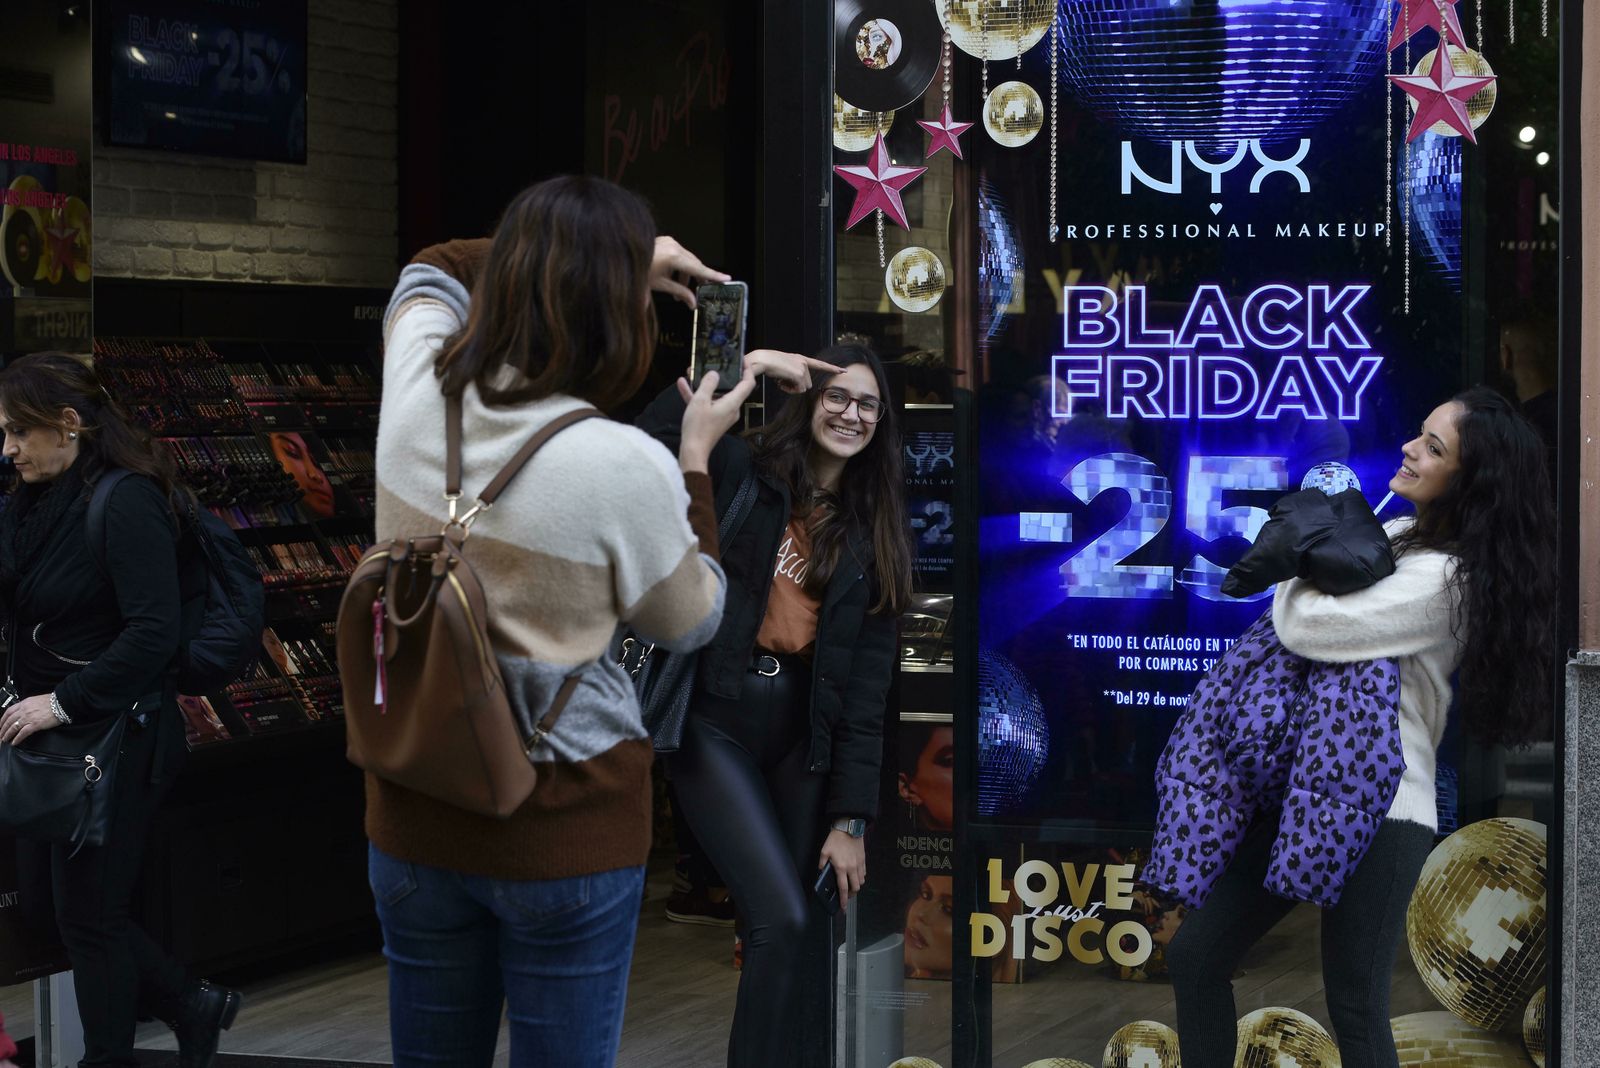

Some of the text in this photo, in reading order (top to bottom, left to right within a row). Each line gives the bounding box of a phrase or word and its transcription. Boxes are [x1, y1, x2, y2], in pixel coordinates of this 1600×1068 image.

[128, 14, 200, 54] BLACK
[128, 50, 204, 88] FRIDAY
[1121, 138, 1311, 194] NYX
[1275, 222, 1386, 238] MAKEUP
[1063, 284, 1372, 350] BLACK
[1051, 355, 1384, 420] FRIDAY
[1092, 636, 1122, 649] TODO
[1127, 637, 1139, 650] EL
[1144, 634, 1200, 652] CATÁLOGO
[1206, 638, 1220, 652] EN
[1119, 657, 1141, 670] POR
[1145, 657, 1198, 672] COMPRAS
[1136, 692, 1150, 706] 29
[1154, 691, 1166, 706] de
[987, 858, 1136, 911] LOVE
[969, 912, 1153, 967] DISCO
